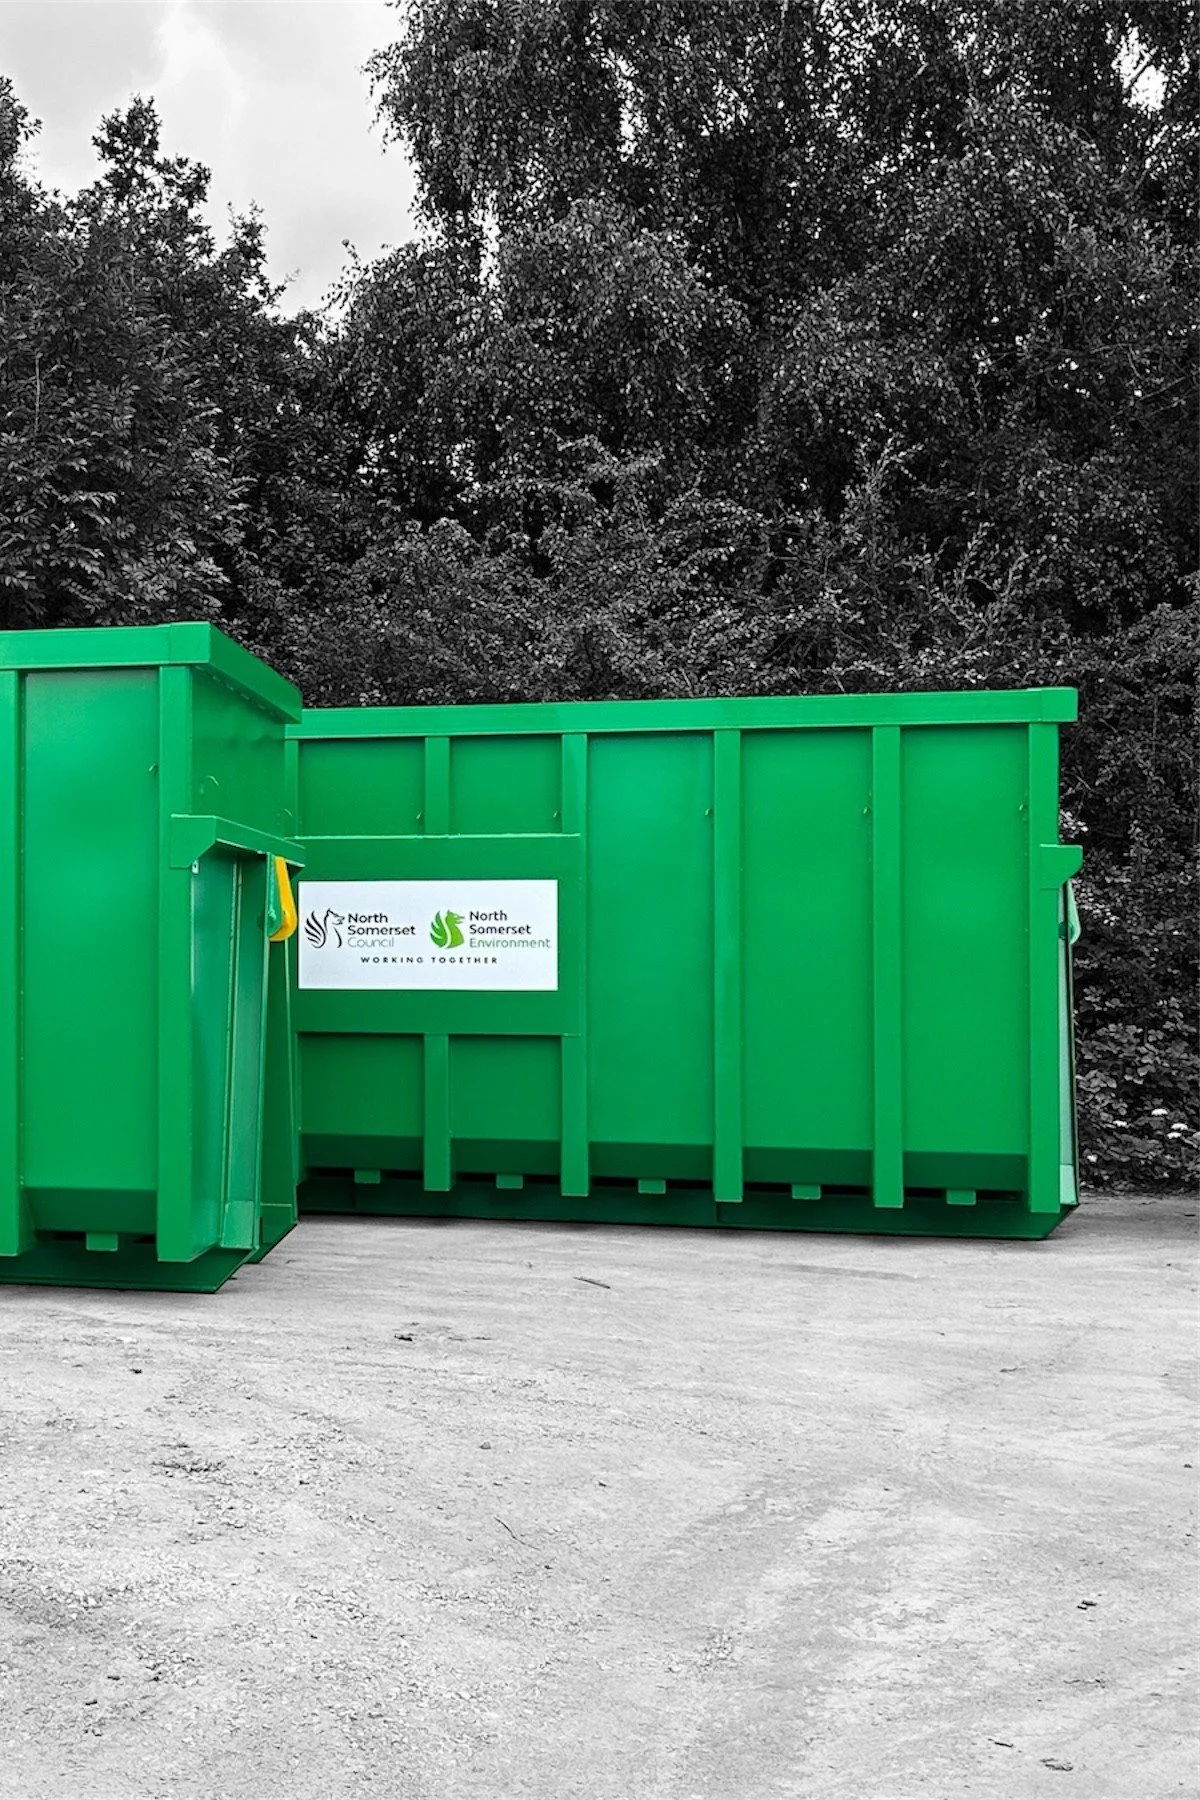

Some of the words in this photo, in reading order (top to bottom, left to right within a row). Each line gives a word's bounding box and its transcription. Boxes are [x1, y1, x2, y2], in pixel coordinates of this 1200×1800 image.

[347, 912, 389, 924] North
[469, 909, 508, 922] North
[347, 924, 416, 936] Somerset
[469, 923, 532, 936] Somerset
[347, 936, 395, 948] Council
[469, 937, 551, 949] Environment
[360, 956, 424, 964] WORKING
[431, 956, 498, 964] TOGETHER
